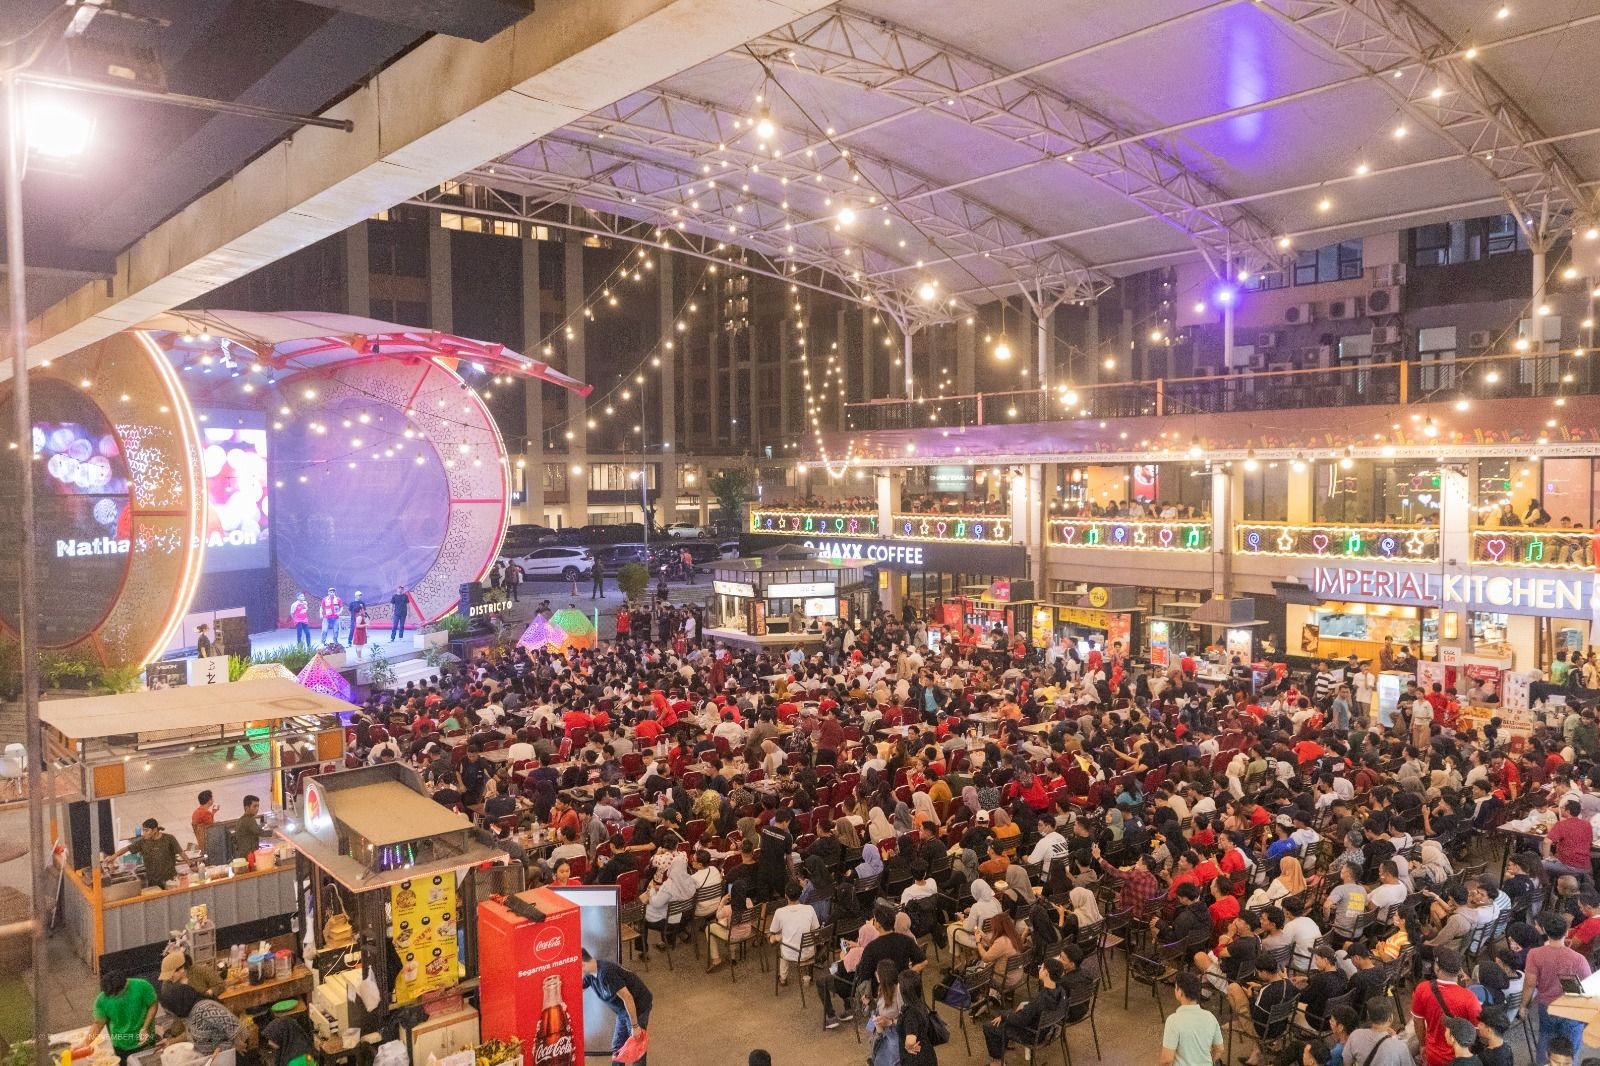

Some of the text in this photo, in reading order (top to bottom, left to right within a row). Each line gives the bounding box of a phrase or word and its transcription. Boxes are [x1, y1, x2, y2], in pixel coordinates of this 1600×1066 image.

[818, 540, 924, 565] MAXX COFFEE
[1313, 566, 1583, 611] IMPERIAL KITCHEN
[535, 935, 562, 952] Coca-Cola
[517, 955, 579, 978] Segarnya mantap
[535, 1035, 573, 1065] Coca-Cola
